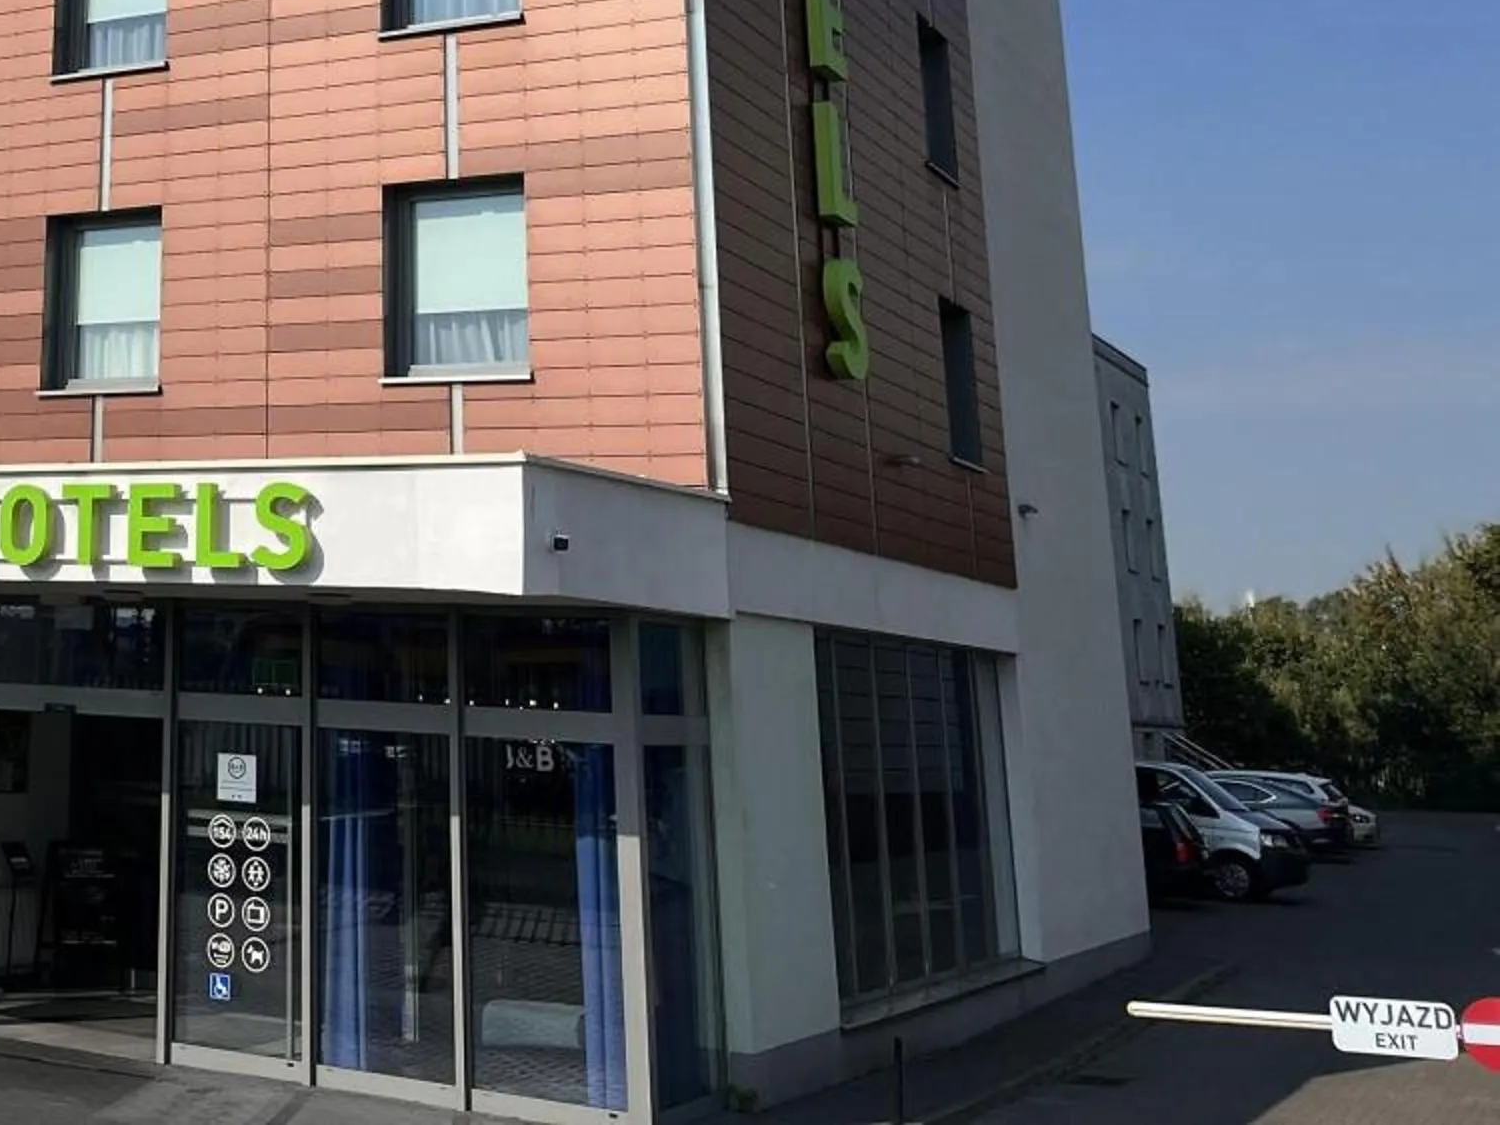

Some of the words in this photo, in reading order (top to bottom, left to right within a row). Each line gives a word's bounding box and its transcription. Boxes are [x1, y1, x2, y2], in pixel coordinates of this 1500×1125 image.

[245, 826, 267, 841] 24h
[215, 898, 229, 921] P
[1334, 1000, 1453, 1030] WYJAZD
[1375, 1032, 1418, 1051] EXIT
